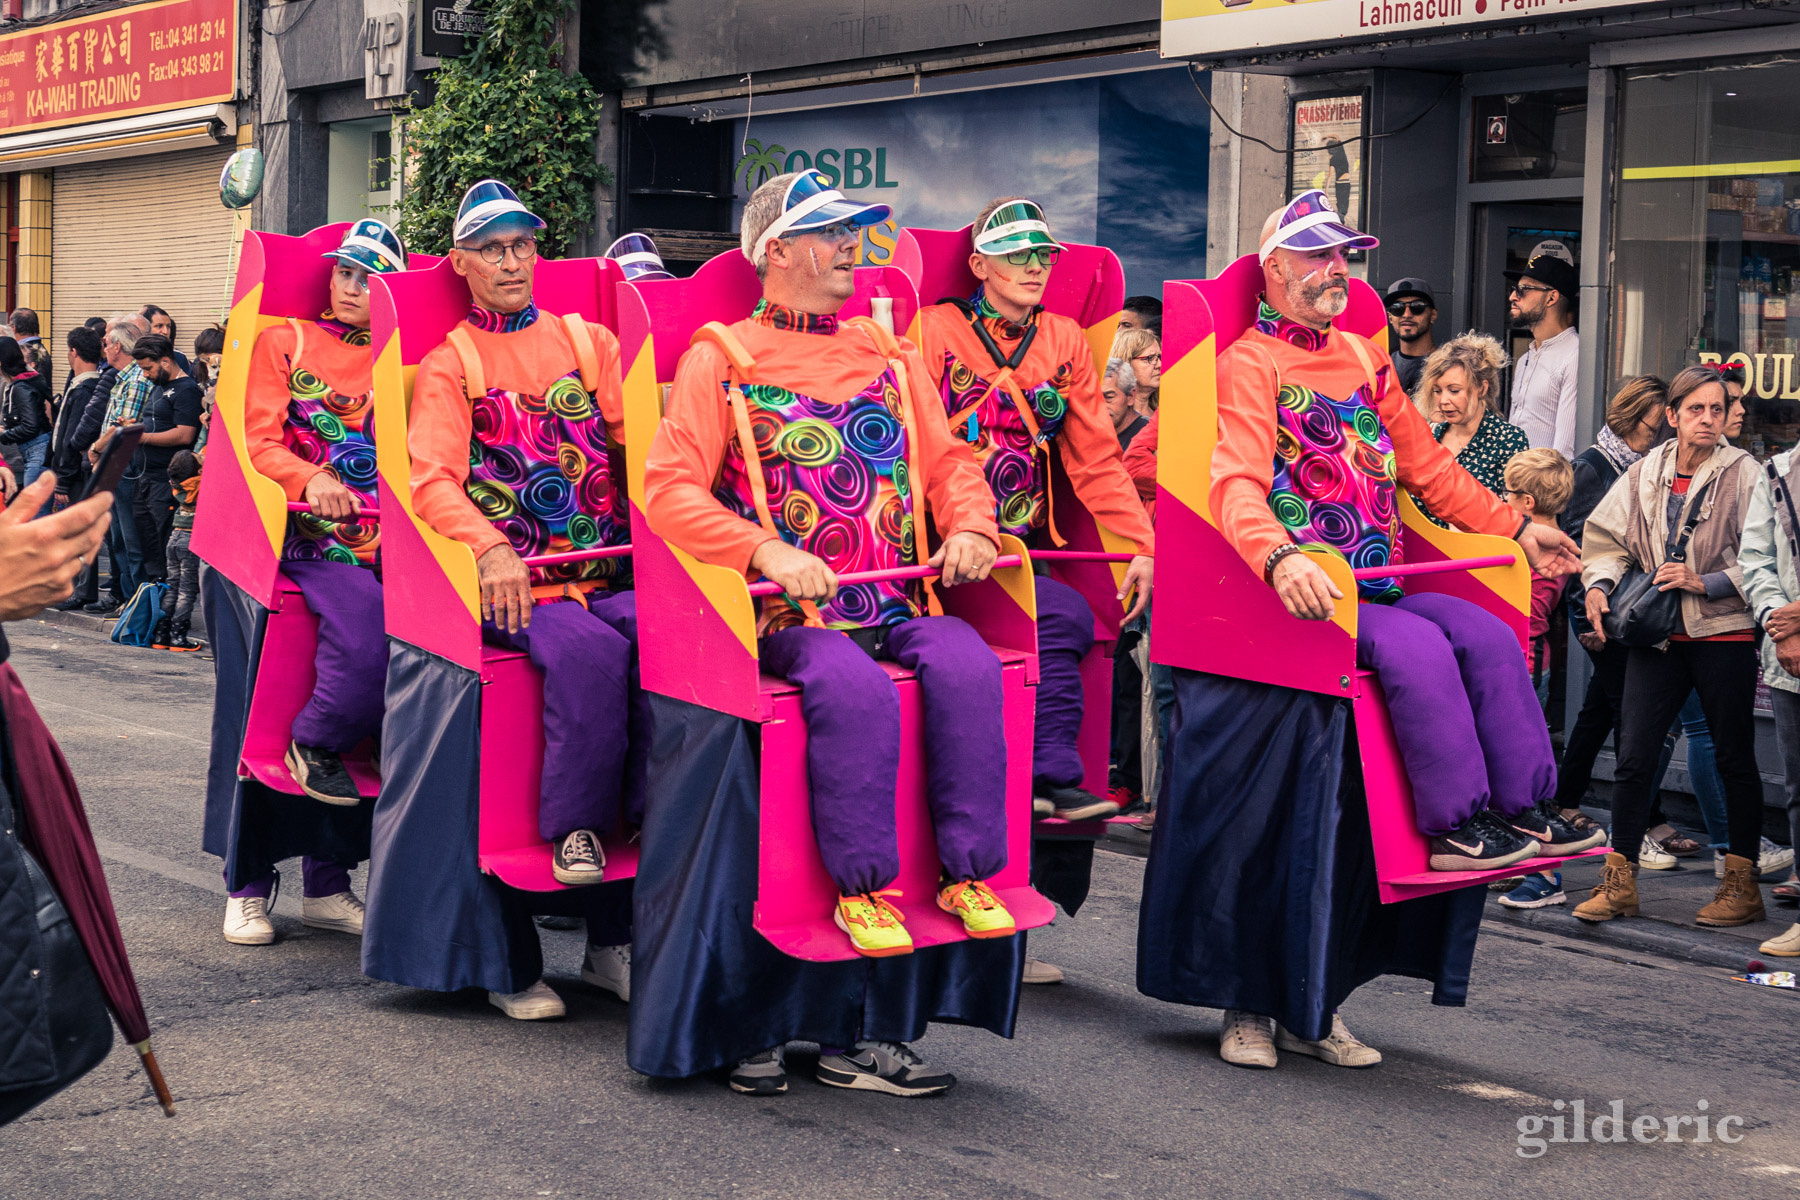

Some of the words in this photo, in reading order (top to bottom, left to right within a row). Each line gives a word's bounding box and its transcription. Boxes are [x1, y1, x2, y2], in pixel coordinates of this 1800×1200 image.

[437, 12, 448, 21] LE
[440, 20, 452, 30] DE
[453, 22, 487, 32] JEANNE
[1360, 0, 1462, 27] Lahmacun
[181, 23, 198, 46] 341
[199, 21, 212, 43] 29
[213, 17, 226, 39] 14
[180, 55, 198, 77] 343
[199, 52, 211, 74] 98
[212, 50, 224, 72] 21
[26, 82, 77, 118] KA-WAH
[79, 71, 141, 110] TRADING
